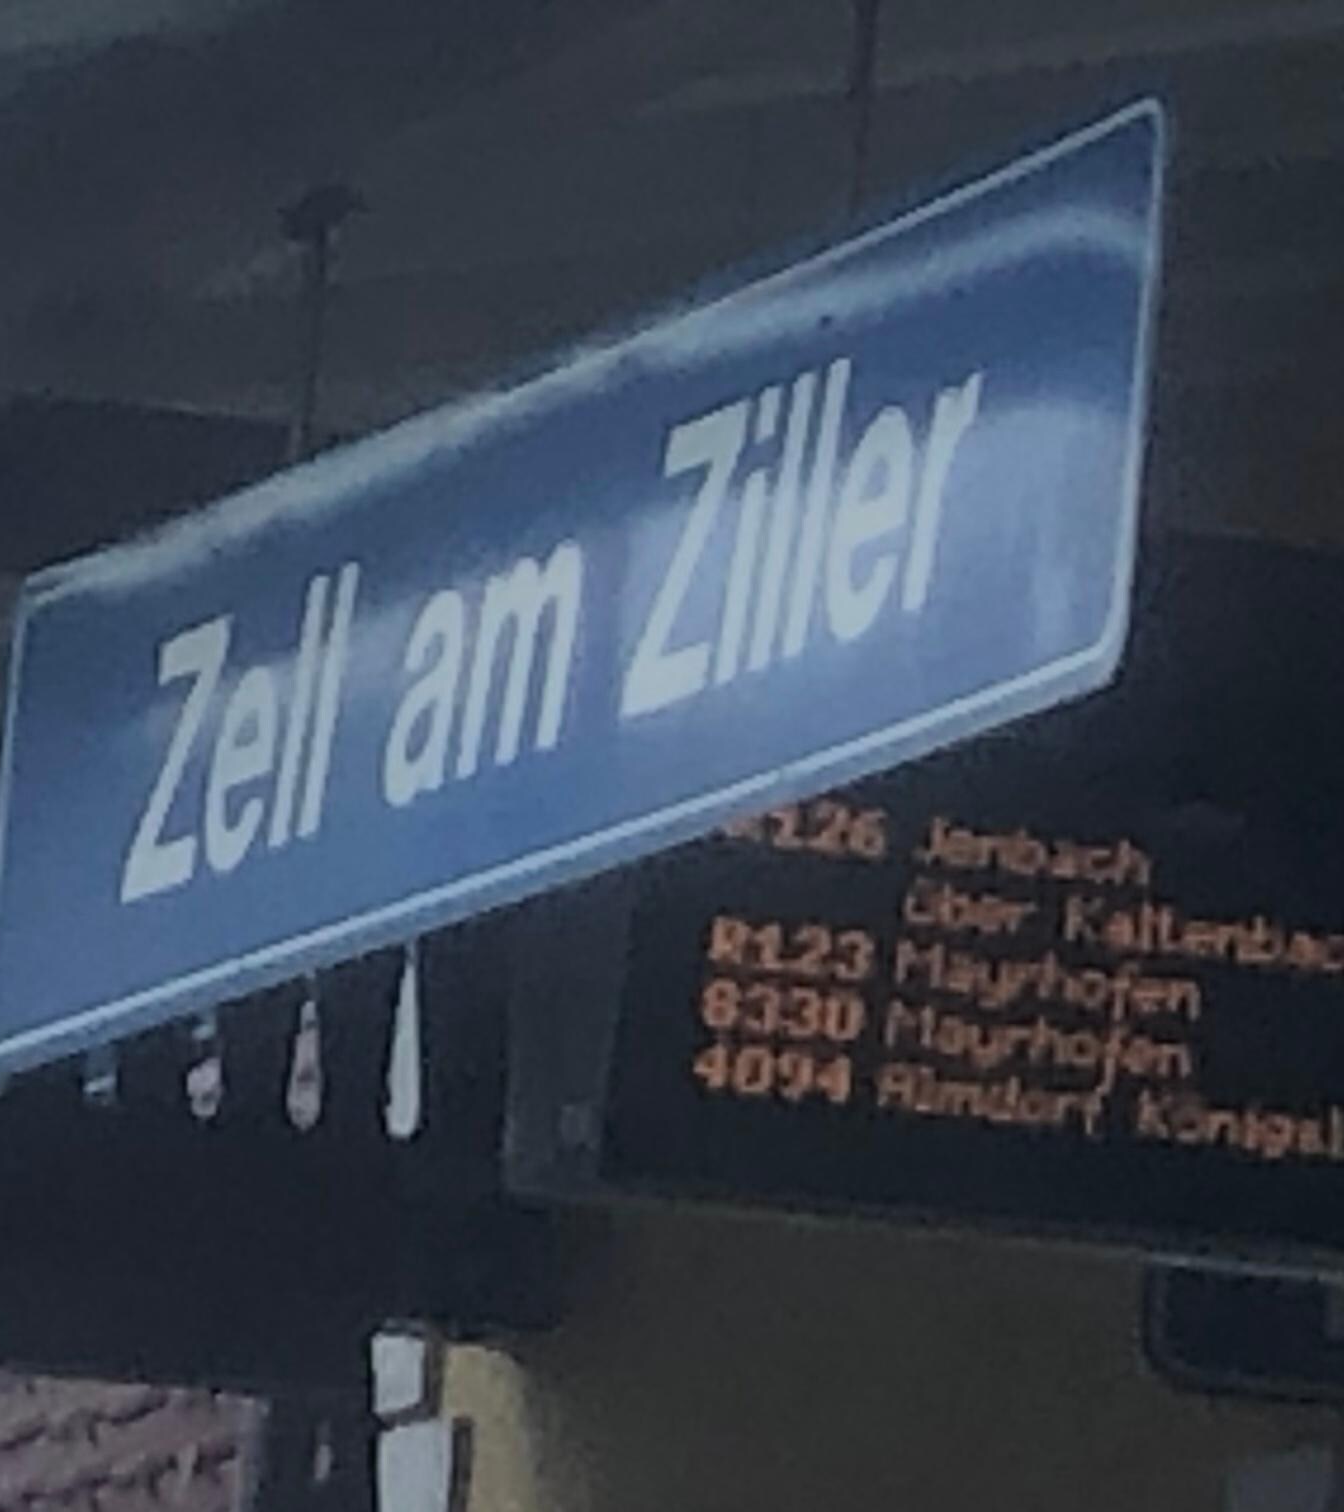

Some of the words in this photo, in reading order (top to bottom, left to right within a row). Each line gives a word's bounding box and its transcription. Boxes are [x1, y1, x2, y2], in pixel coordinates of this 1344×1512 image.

[120, 562, 358, 905] Zell
[384, 541, 581, 805] am
[618, 357, 984, 717] Ziller
[918, 817, 1152, 886] Jenbach
[708, 914, 877, 981] R123
[895, 939, 1202, 1023] Mayrhofen
[700, 976, 867, 1042] 8330
[884, 999, 1192, 1088] Mayrhofen
[693, 1043, 854, 1106] 4094
[876, 1062, 1103, 1137] Almdorf
